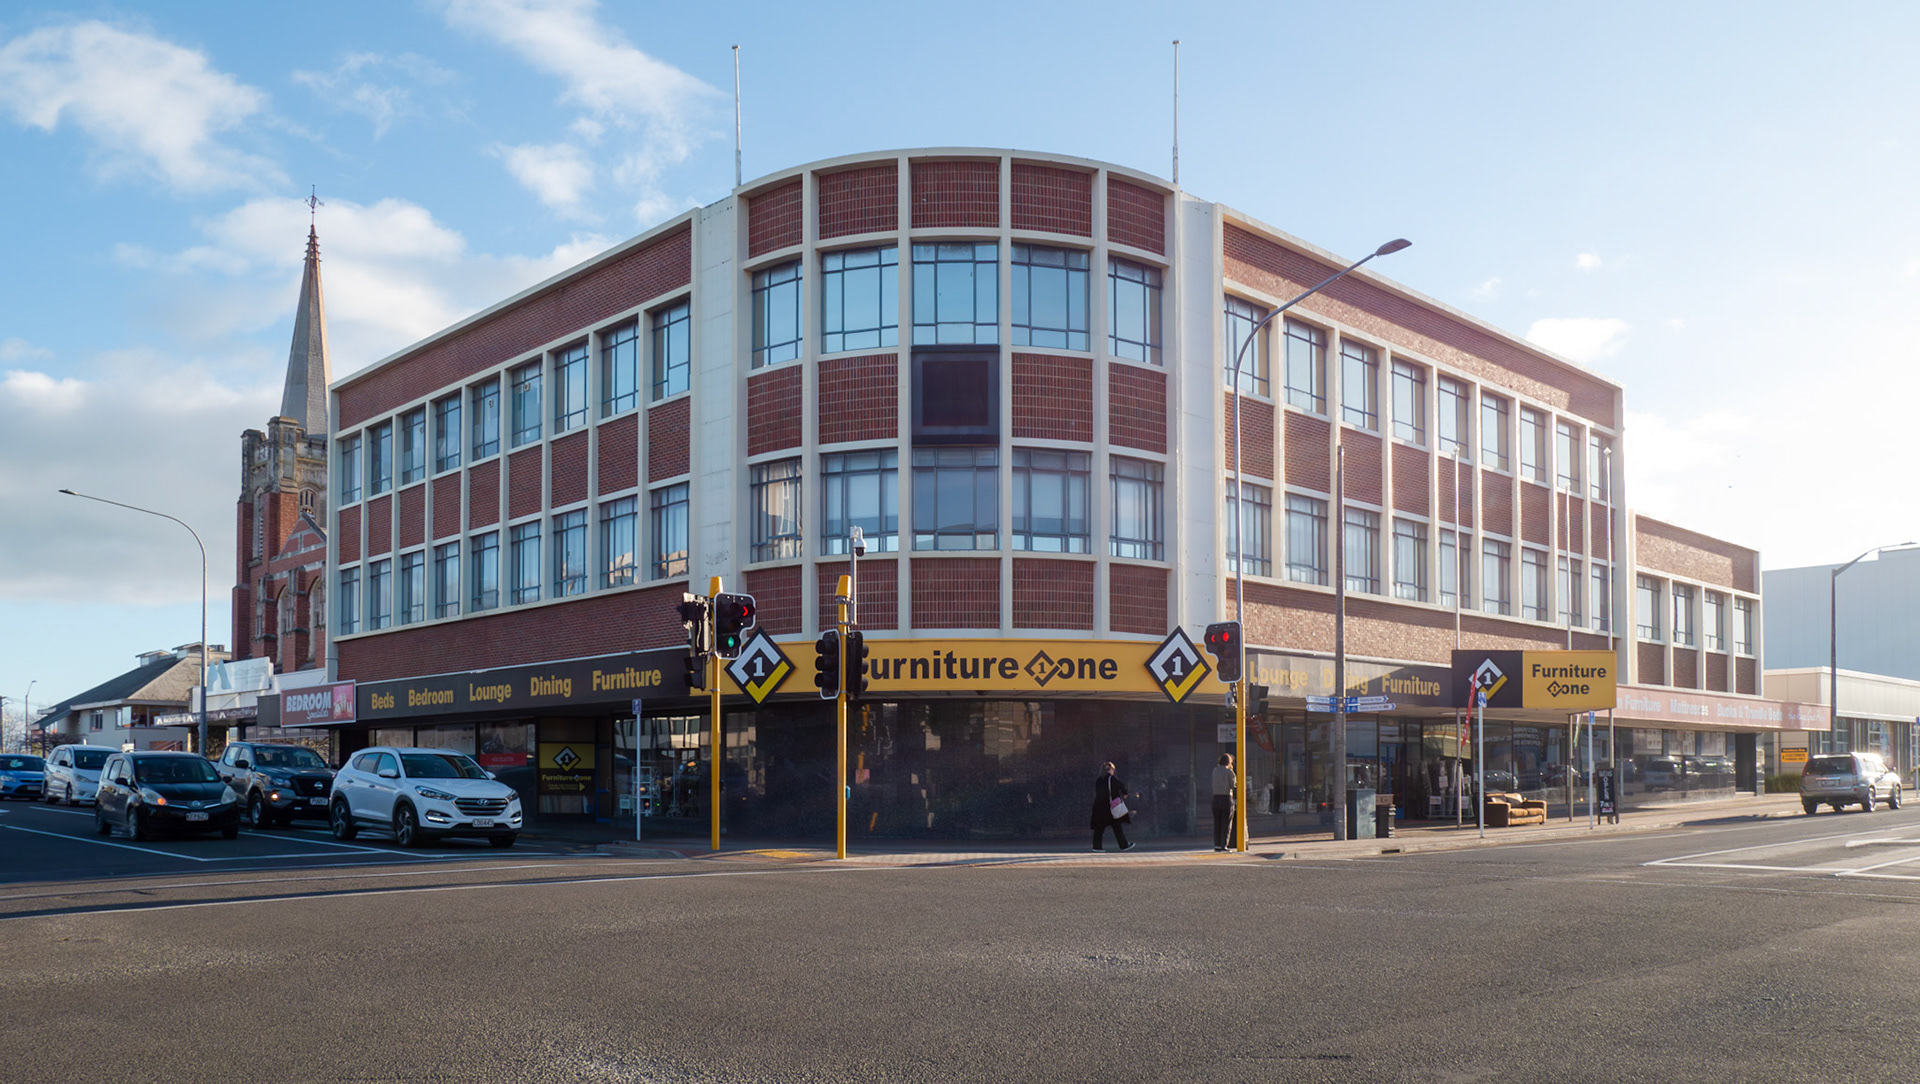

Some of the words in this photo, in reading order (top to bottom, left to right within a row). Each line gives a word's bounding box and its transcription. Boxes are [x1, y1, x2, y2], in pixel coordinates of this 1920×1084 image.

[752, 656, 765, 677] 1
[868, 650, 1019, 680] urniture
[1037, 662, 1047, 674] 1
[1056, 656, 1118, 680] one
[1171, 655, 1184, 677] 1
[1532, 664, 1607, 678] Furniture
[371, 692, 395, 710] Beds
[408, 688, 454, 707] Bedroom
[469, 683, 512, 703] Lounge
[530, 675, 572, 698] Dining
[592, 667, 662, 691] Furniture
[1250, 661, 1308, 690] Lounge
[1323, 668, 1369, 695] Ding
[1382, 673, 1441, 696] Furniture
[1483, 672, 1493, 685] 1
[1561, 684, 1590, 695] one
[286, 691, 332, 713] BEDROOM
[1625, 694, 1661, 713] Furniture
[1670, 698, 1709, 717] Mattresses
[1717, 703, 1738, 719] Bunks
